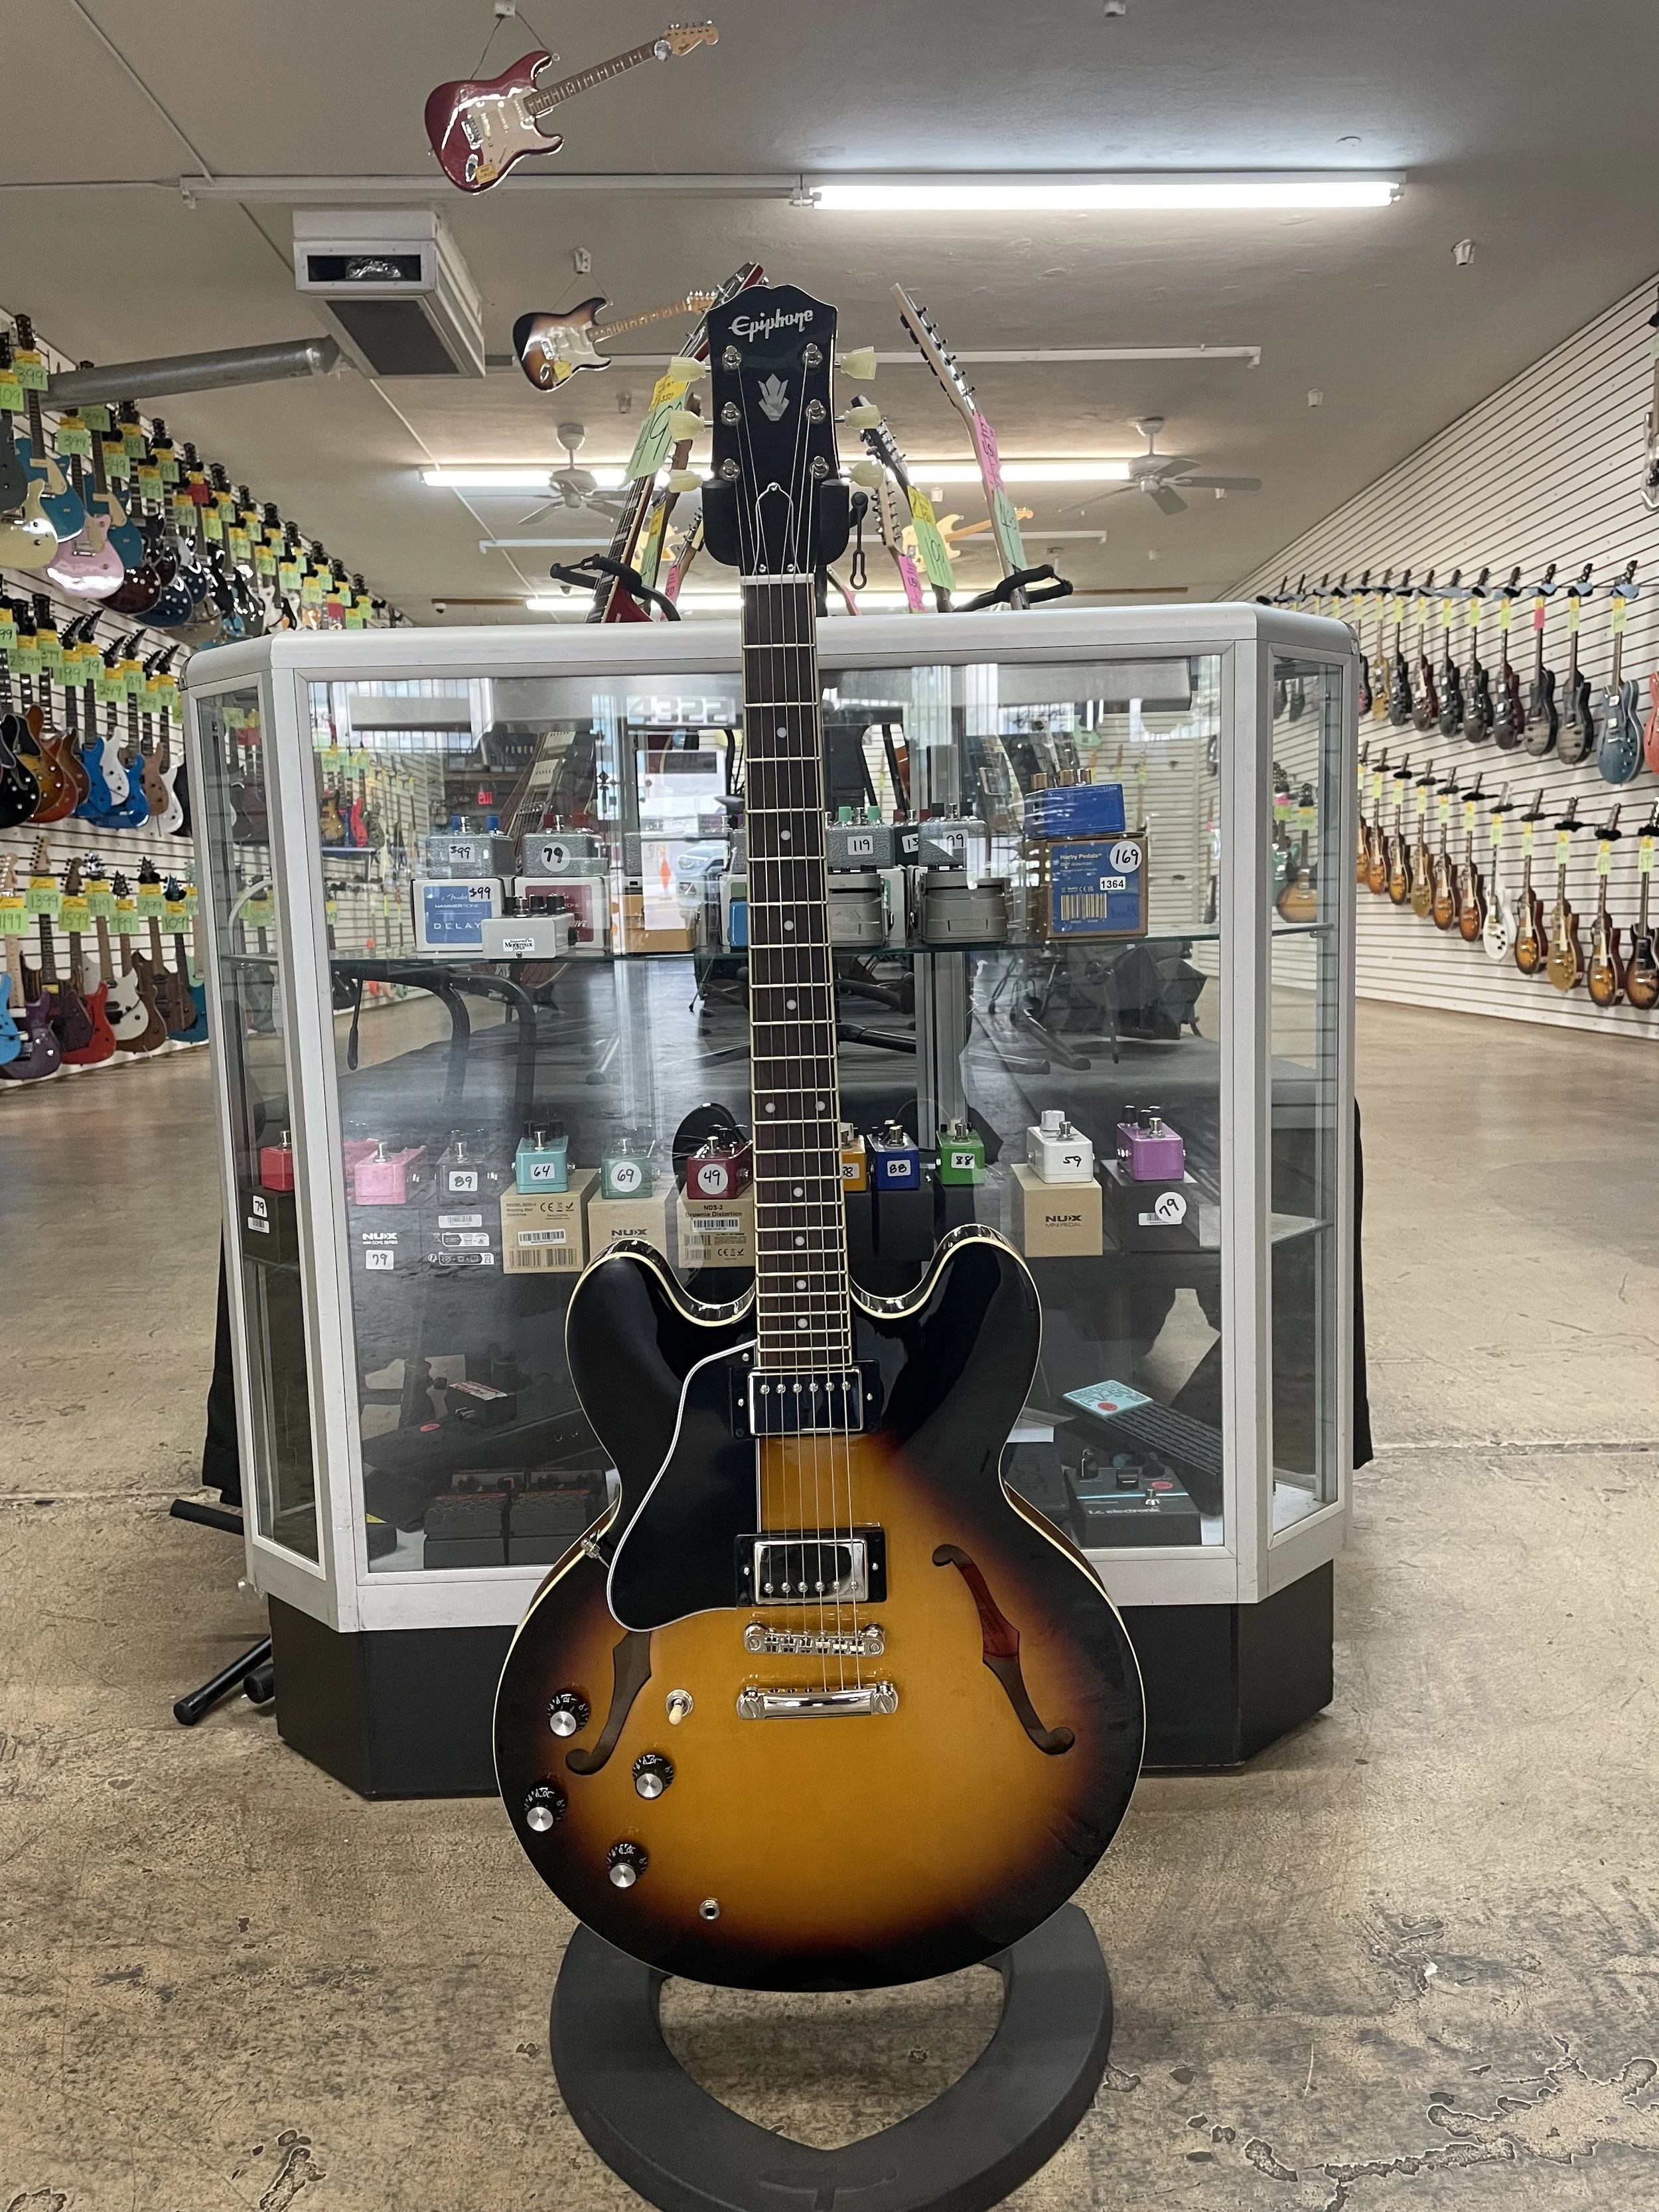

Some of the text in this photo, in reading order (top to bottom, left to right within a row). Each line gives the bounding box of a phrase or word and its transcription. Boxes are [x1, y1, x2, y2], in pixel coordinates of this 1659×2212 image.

[729, 309, 813, 342] Epiphone
[628, 698, 728, 724] 4322
[853, 840, 870, 851] 119
[450, 846, 470, 859] $99
[544, 848, 563, 863] 79
[1116, 849, 1139, 865] 169
[1101, 879, 1124, 889] 1364
[469, 887, 491, 900] $99
[956, 1155, 974, 1166] 88
[534, 1165, 551, 1177] 64
[889, 1163, 907, 1173] 88
[454, 1175, 472, 1188] 89
[617, 1169, 634, 1183] 69
[703, 1170, 721, 1186] 49
[254, 1201, 264, 1215] 79
[1159, 1198, 1179, 1217] 79
[372, 1253, 388, 1266] 79
